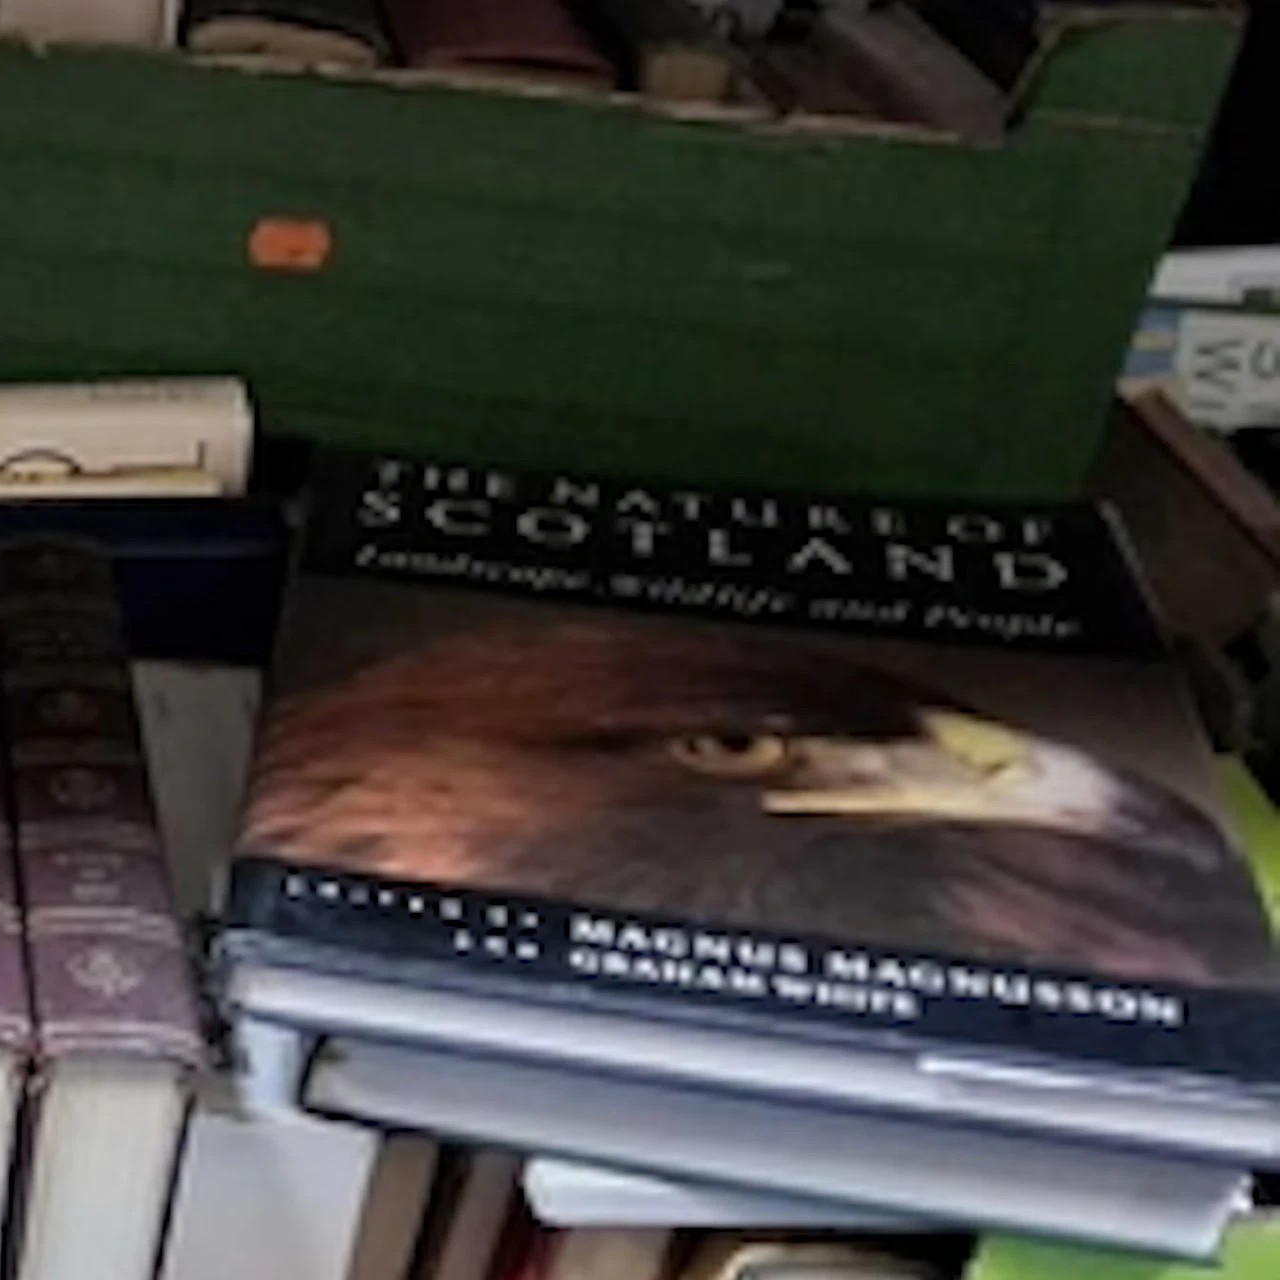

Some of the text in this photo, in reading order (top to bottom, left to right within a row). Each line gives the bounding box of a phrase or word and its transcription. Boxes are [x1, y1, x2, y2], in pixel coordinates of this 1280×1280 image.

[354, 489, 1070, 592] SCOTLAND
[548, 475, 908, 536] NATURE
[566, 948, 768, 996] GRAHAM
[770, 972, 922, 1020] WHITE
[568, 912, 810, 972] MAGNUS
[828, 949, 1184, 1025] MAGNUSSON
